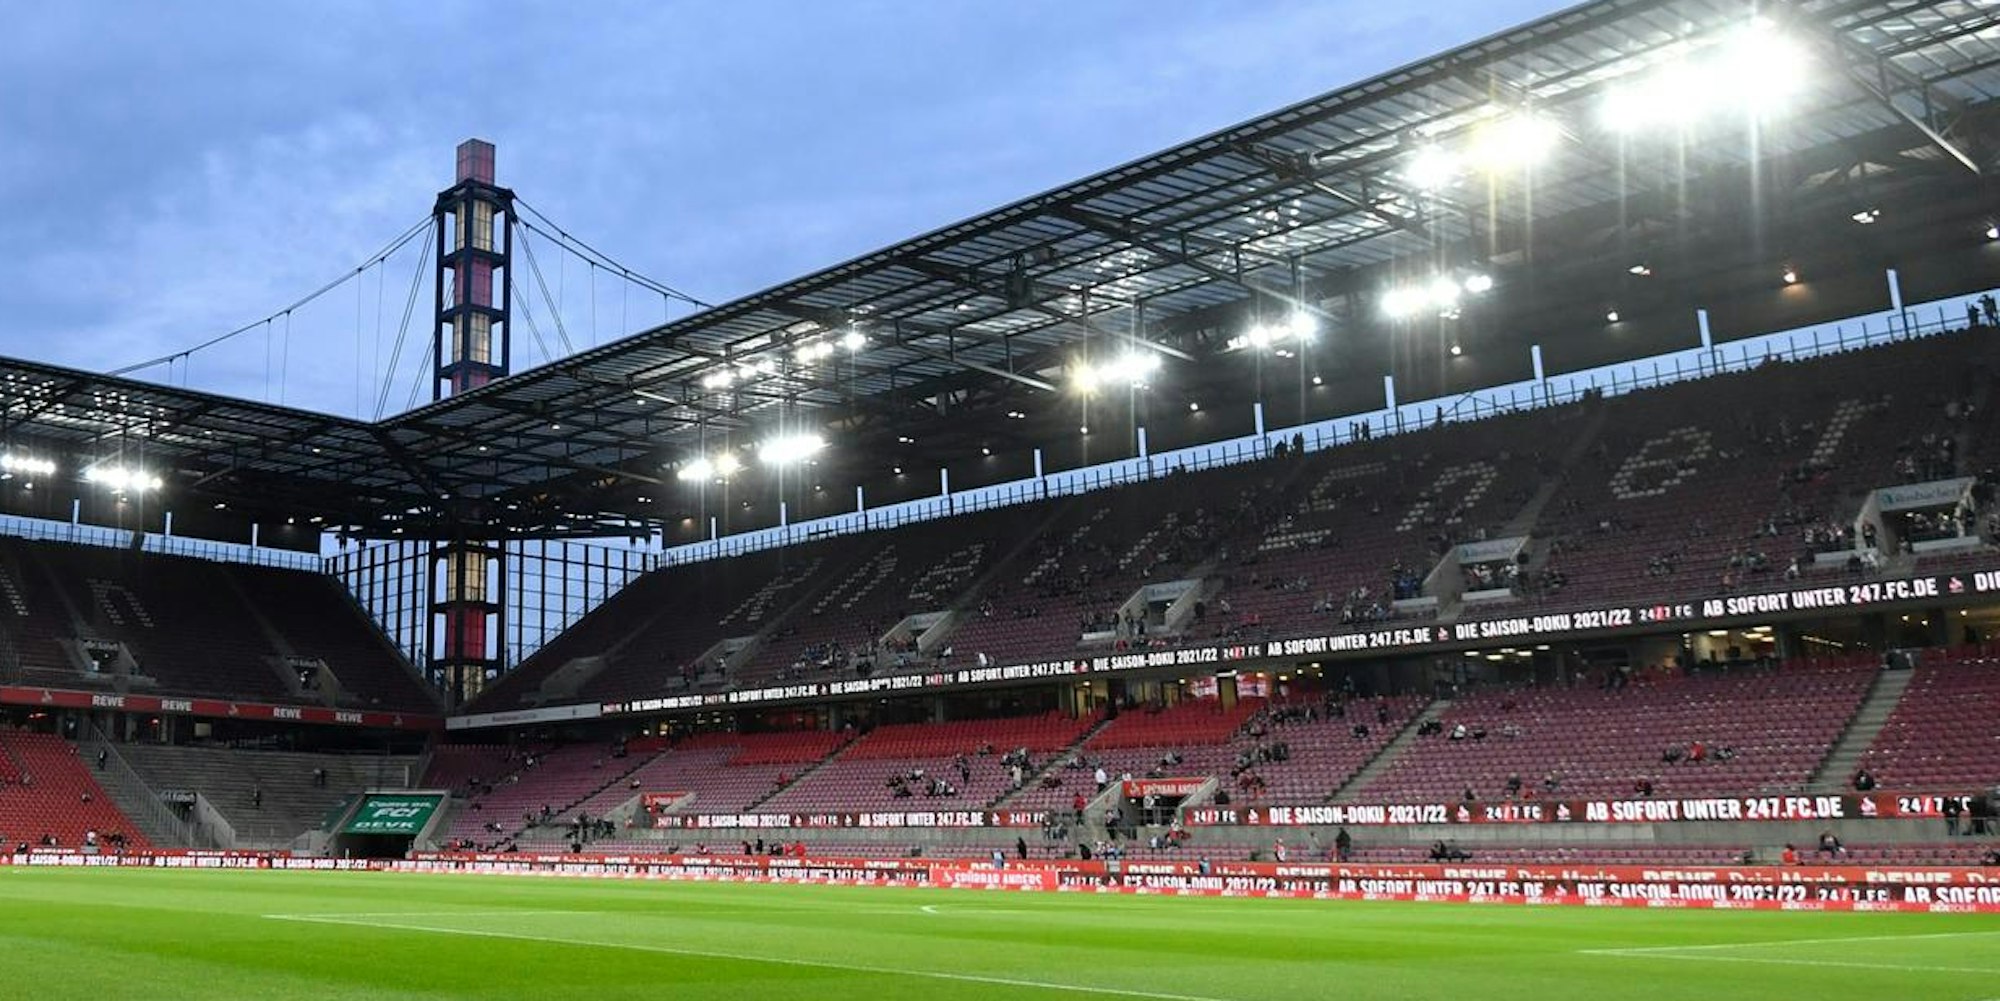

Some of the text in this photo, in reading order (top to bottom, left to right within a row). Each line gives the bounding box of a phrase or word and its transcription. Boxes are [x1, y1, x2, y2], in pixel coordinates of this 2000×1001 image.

[892, 675, 922, 690] 2021/22
[958, 670, 969, 683] AB
[970, 667, 1002, 682] SOFORT
[1003, 664, 1031, 681] UNTER
[1031, 660, 1076, 678] 247.FC.DE
[1092, 657, 1110, 672] DIE
[1110, 651, 1175, 671] SAISON-DOKU
[1176, 647, 1218, 665] 2021/22
[1267, 641, 1283, 656] AB
[1284, 636, 1328, 655] SOFORT
[1329, 633, 1367, 651] UNTER
[1369, 627, 1431, 648] 247.FC.DE
[1455, 622, 1478, 640] DIE
[1480, 614, 1571, 638] SAISON-DOKU
[1573, 608, 1632, 629] 2021/22
[1674, 604, 1692, 617] FC
[1702, 599, 1724, 617] AB
[1726, 592, 1788, 615] SOFORT
[1791, 587, 1846, 609] UNTER
[1849, 577, 1938, 604] 247.FC.DE
[92, 695, 362, 723] REWE REWE REWE REWE
[372, 807, 421, 818] FC!
[859, 814, 871, 826] AB
[872, 813, 905, 826] SOFORT
[906, 812, 936, 826] UNTER
[936, 812, 985, 826] 247.FC.DE
[1193, 810, 1220, 823] 24/7
[1222, 810, 1236, 823] FC
[1269, 807, 1293, 824] DIE
[1294, 806, 1385, 824] SAISON-DOKU
[1387, 805, 1447, 823] 2021/22
[1486, 806, 1519, 819] 24/7
[1523, 806, 1541, 819] FC
[1585, 802, 1608, 821] AB
[1612, 800, 1678, 821] SOFORT
[1681, 799, 1741, 820] UNTER
[1744, 796, 1844, 818] 247.FC.DE
[1899, 797, 1943, 812] 24/7
[355, 821, 416, 829] DEVK
[1003, 872, 1042, 885] ANDERS
[1123, 875, 1143, 887] DE
[1145, 876, 1223, 890] SAISON-DOKU
[1225, 877, 1277, 890] 2021/22
[1359, 879, 1413, 894] SOFORT
[1415, 880, 1463, 895] UNTER
[1466, 881, 1544, 896] 247FCDE
[1577, 883, 1606, 898] DIE
[1609, 883, 1727, 900] SAISON-DOKU
[1865, 888, 1889, 902] FC
[1904, 886, 1931, 903] AB
